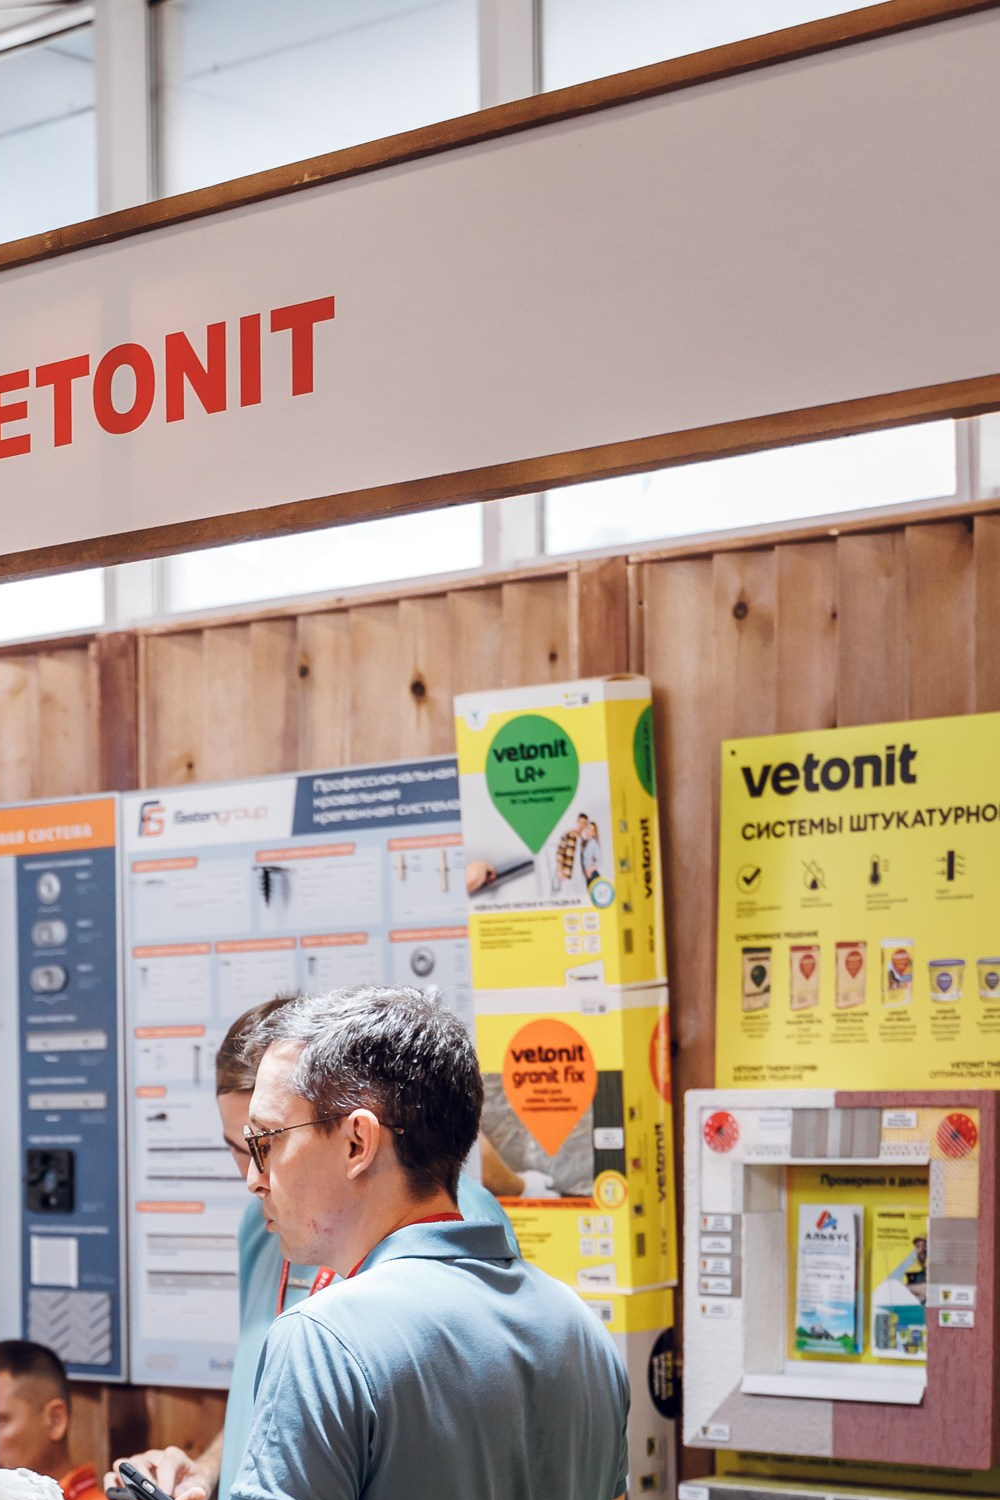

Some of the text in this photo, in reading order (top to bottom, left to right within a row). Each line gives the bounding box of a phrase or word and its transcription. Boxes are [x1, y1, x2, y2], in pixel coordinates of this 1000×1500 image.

[492, 738, 570, 763] vetonit
[514, 766, 547, 784] LR+
[740, 743, 918, 799] vetonit
[740, 803, 1000, 842] СИСТЕМЫ ШТУКАТУРНО
[511, 1045, 585, 1064] vetonit
[511, 1066, 585, 1090] granit fix
[803, 1232, 850, 1242] АЛЬБУС
